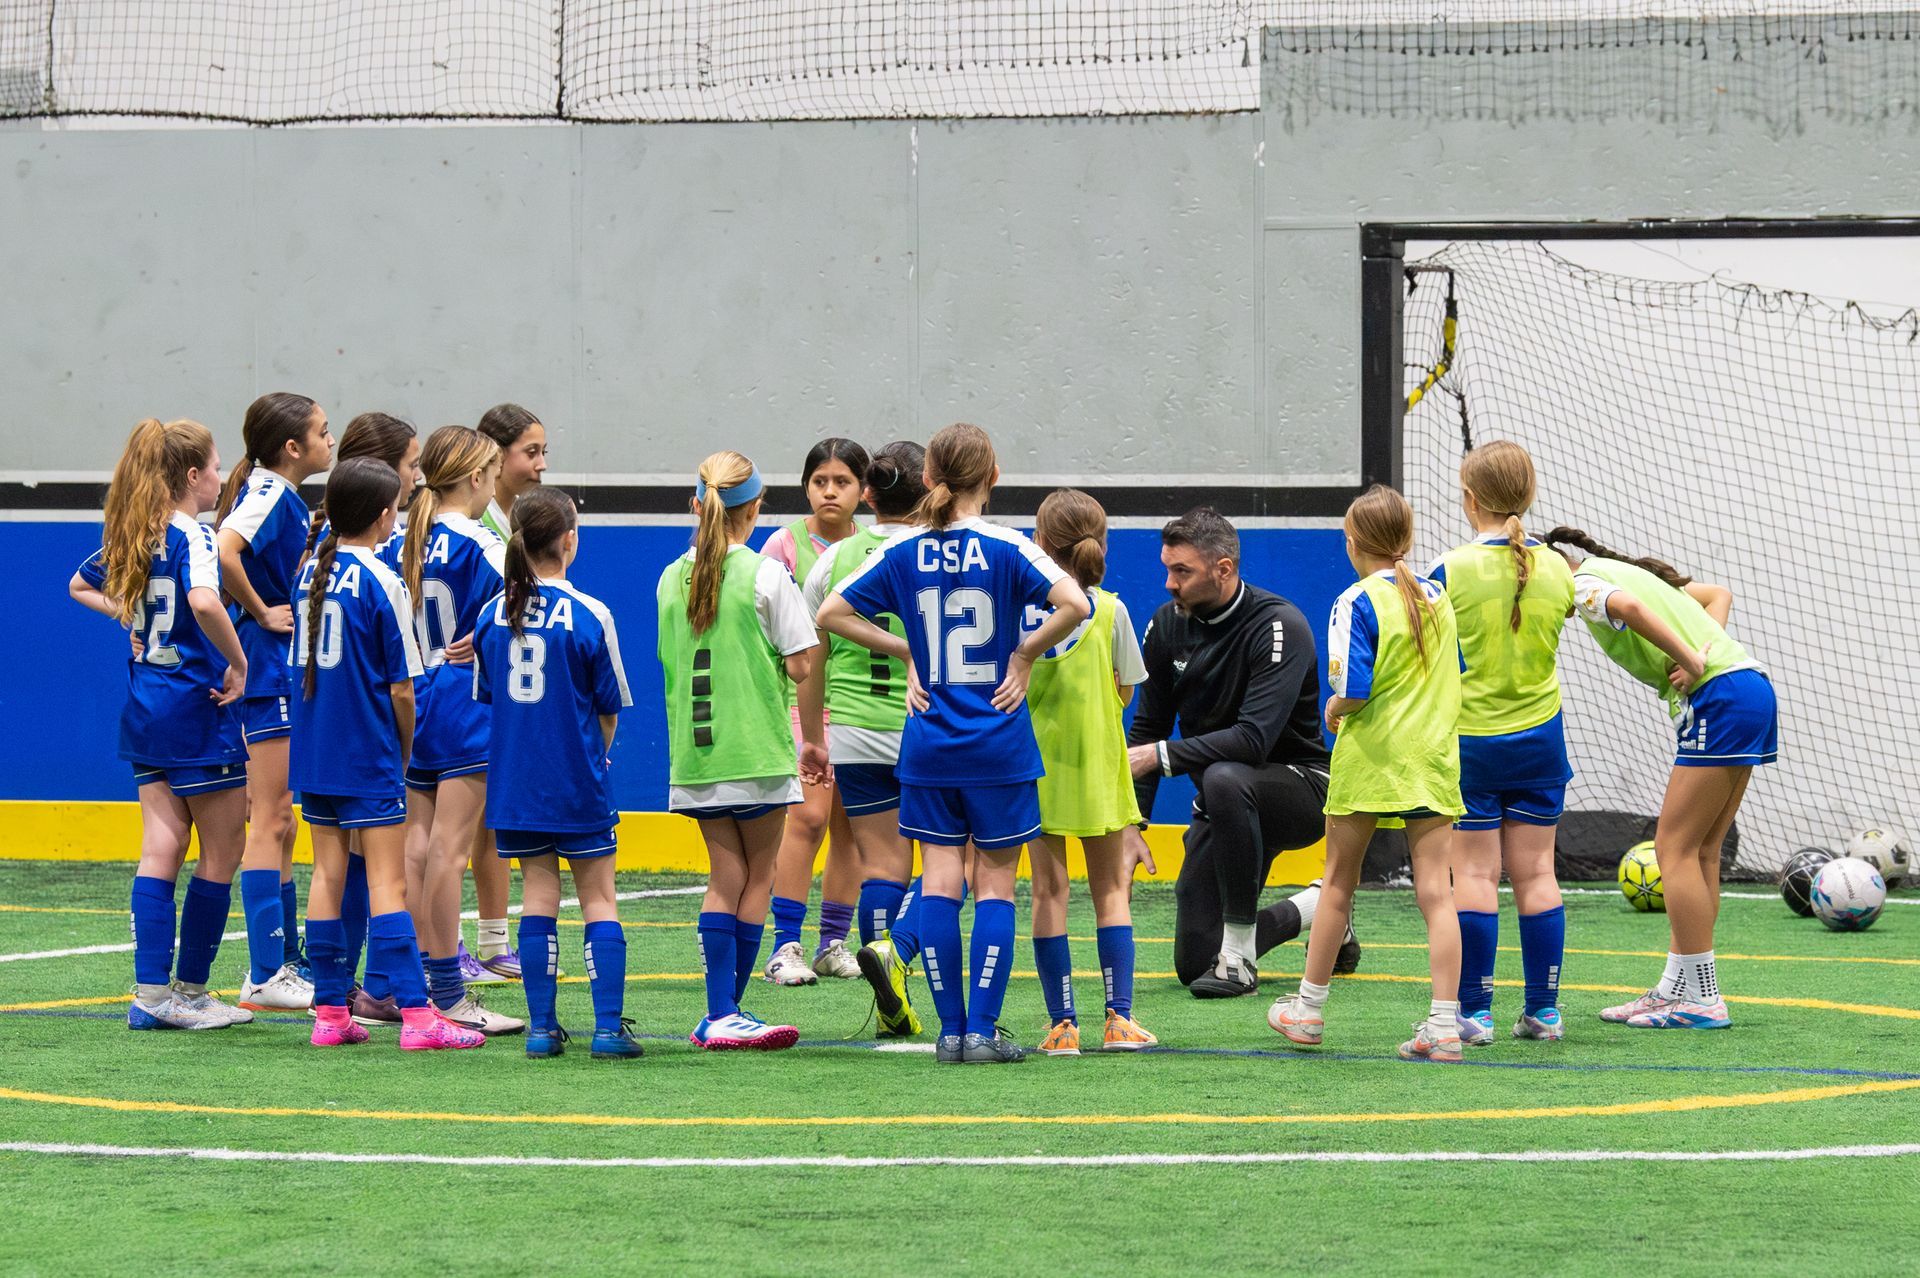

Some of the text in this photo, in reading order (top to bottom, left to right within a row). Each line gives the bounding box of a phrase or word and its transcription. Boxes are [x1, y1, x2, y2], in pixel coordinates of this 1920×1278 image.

[917, 537, 989, 574] CSA
[296, 598, 344, 670] 10
[507, 633, 546, 704] 8
[915, 586, 997, 686] 12
